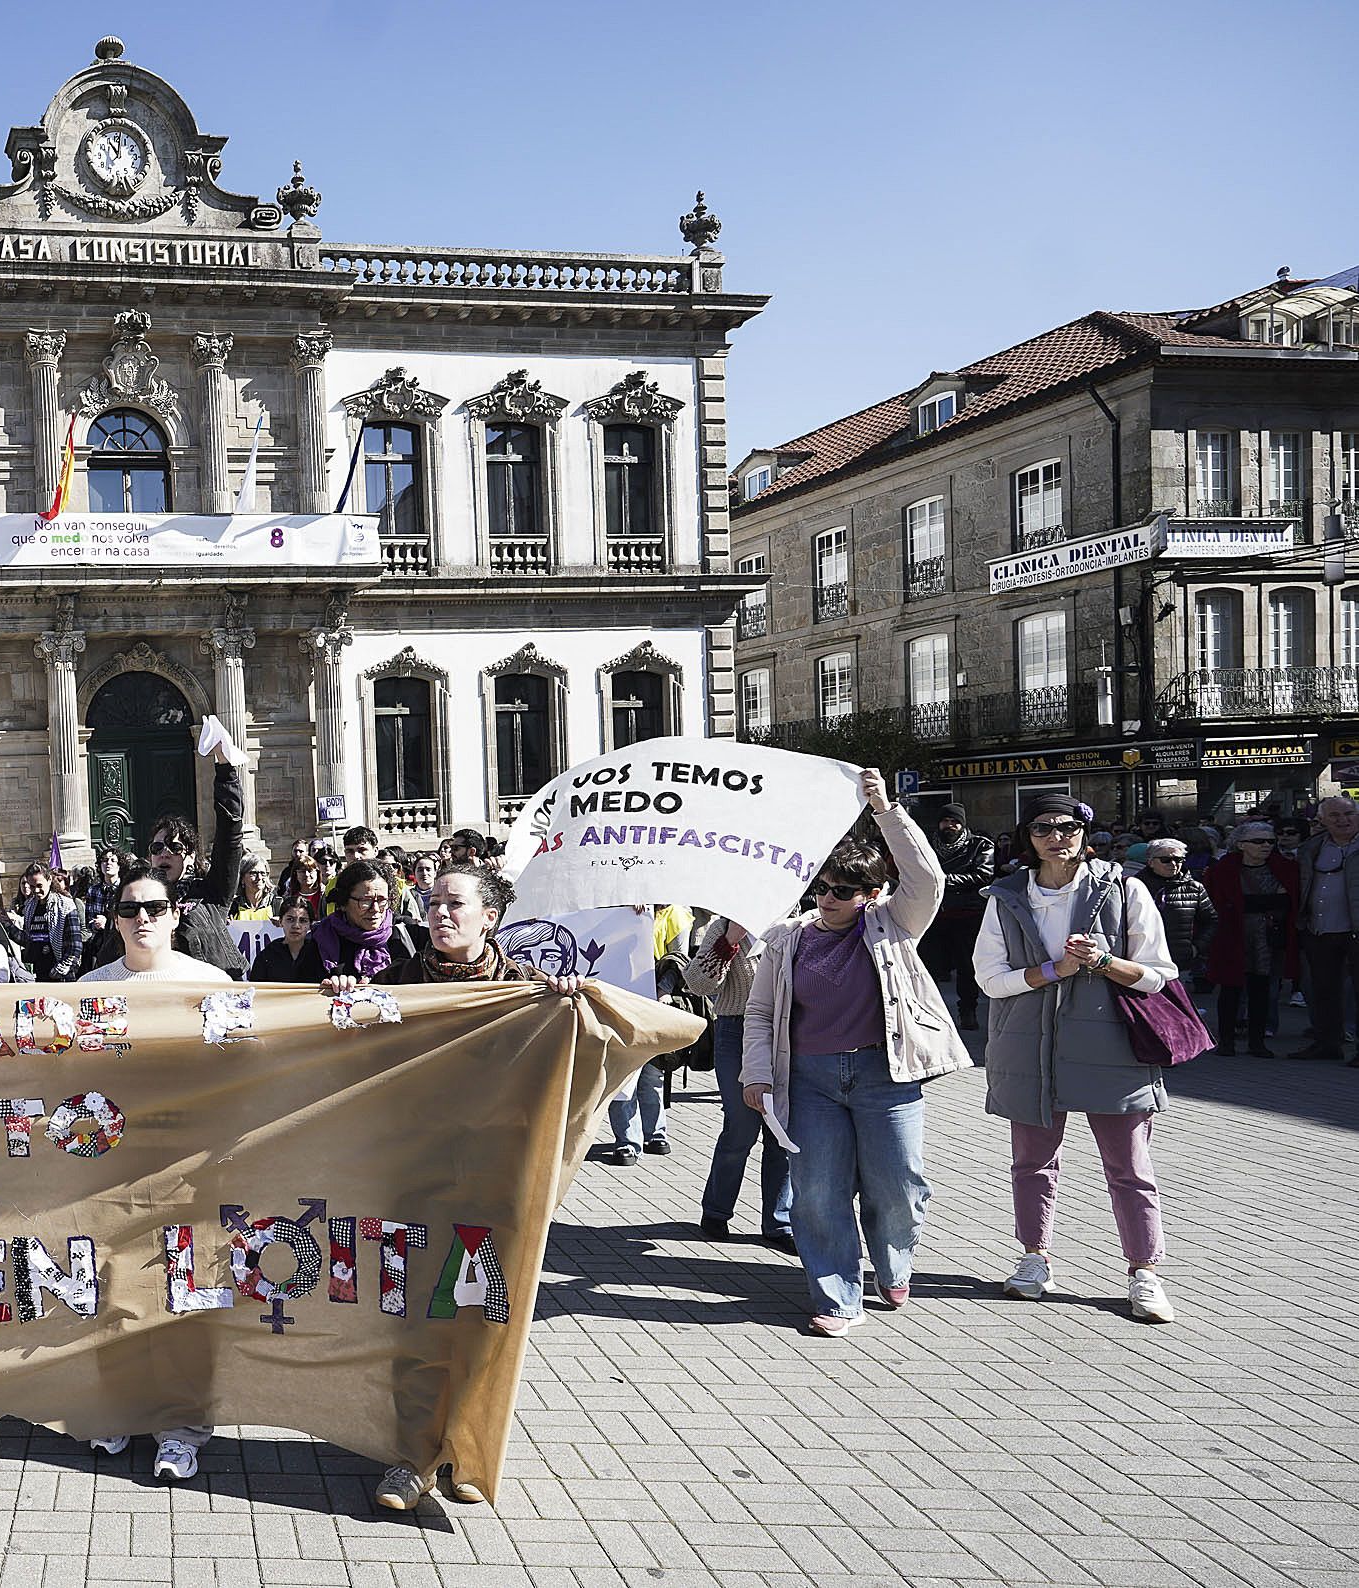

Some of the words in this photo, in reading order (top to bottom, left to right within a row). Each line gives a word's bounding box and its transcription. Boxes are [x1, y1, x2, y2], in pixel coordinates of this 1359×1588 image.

[75, 238, 262, 266] CONSISTORIAL
[34, 520, 61, 531] Non
[63, 522, 86, 531] van
[11, 534, 36, 546] que
[39, 535, 48, 544] o
[91, 535, 114, 544] nos
[116, 533, 149, 544] volva
[270, 528, 284, 548] 8
[1167, 529, 1221, 543] LINICA
[1229, 529, 1289, 543] DENTAL
[105, 548, 120, 556] na
[123, 548, 150, 557] casa
[993, 554, 1060, 580] CLINICA
[1069, 533, 1146, 563] DENTAL
[991, 547, 1149, 592] CIRUGIA-PROTESIS-ORTODONCIA-IMPLANTES
[1064, 752, 1100, 761] GESTION
[1150, 743, 1195, 752] COMPRA-VENTA
[940, 757, 1050, 778] ICHELENA
[1057, 759, 1111, 770] INMOBILIARIA
[1202, 760, 1243, 768] GESTION
[1246, 757, 1306, 767] INMOBILIARIA
[651, 761, 764, 795] TEMOS
[902, 774, 914, 792] P
[570, 790, 683, 818] MEDO
[579, 825, 816, 883] ANTIFASCISTAS
[164, 1214, 510, 1325] LOITA
